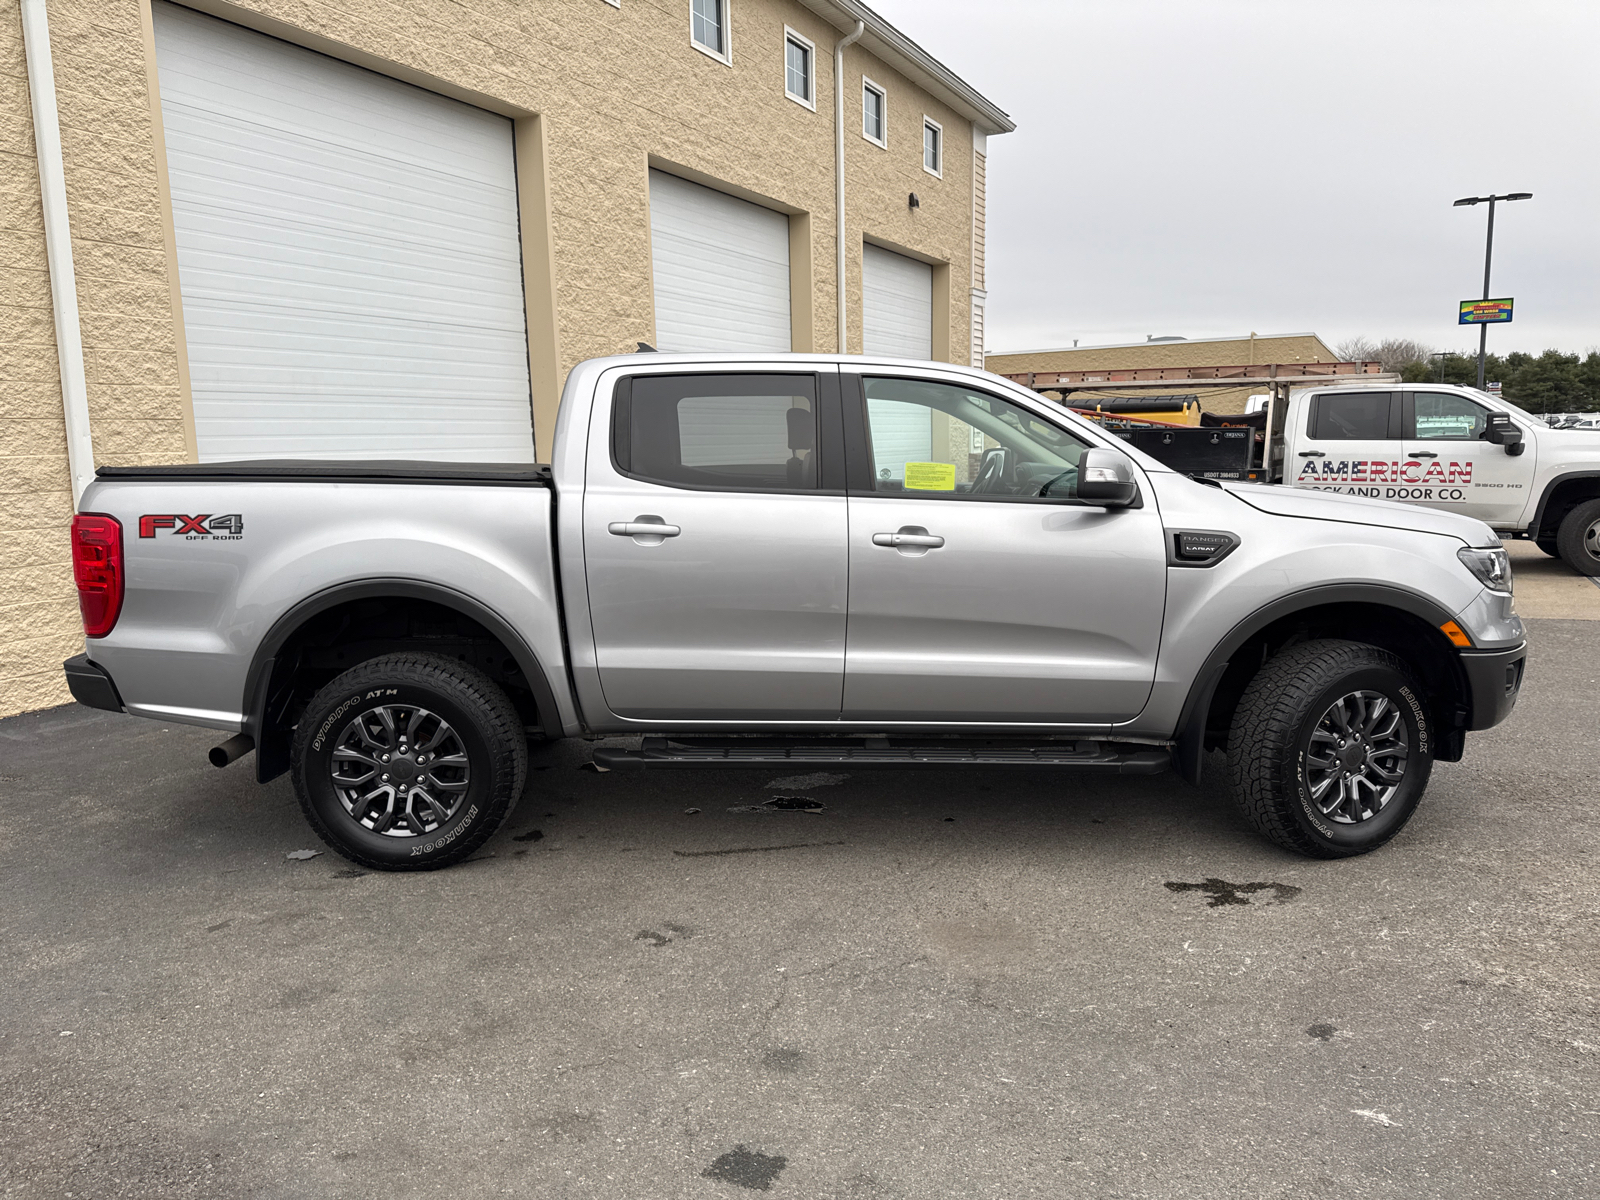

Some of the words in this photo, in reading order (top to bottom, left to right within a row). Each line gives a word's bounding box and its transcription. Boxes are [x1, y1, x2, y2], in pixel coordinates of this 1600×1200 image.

[1298, 460, 1473, 483] AMERICAN
[1347, 487, 1380, 498] AND
[1386, 488, 1432, 500] DOOR
[1438, 489, 1466, 501] CO.
[139, 514, 243, 538] FX4
